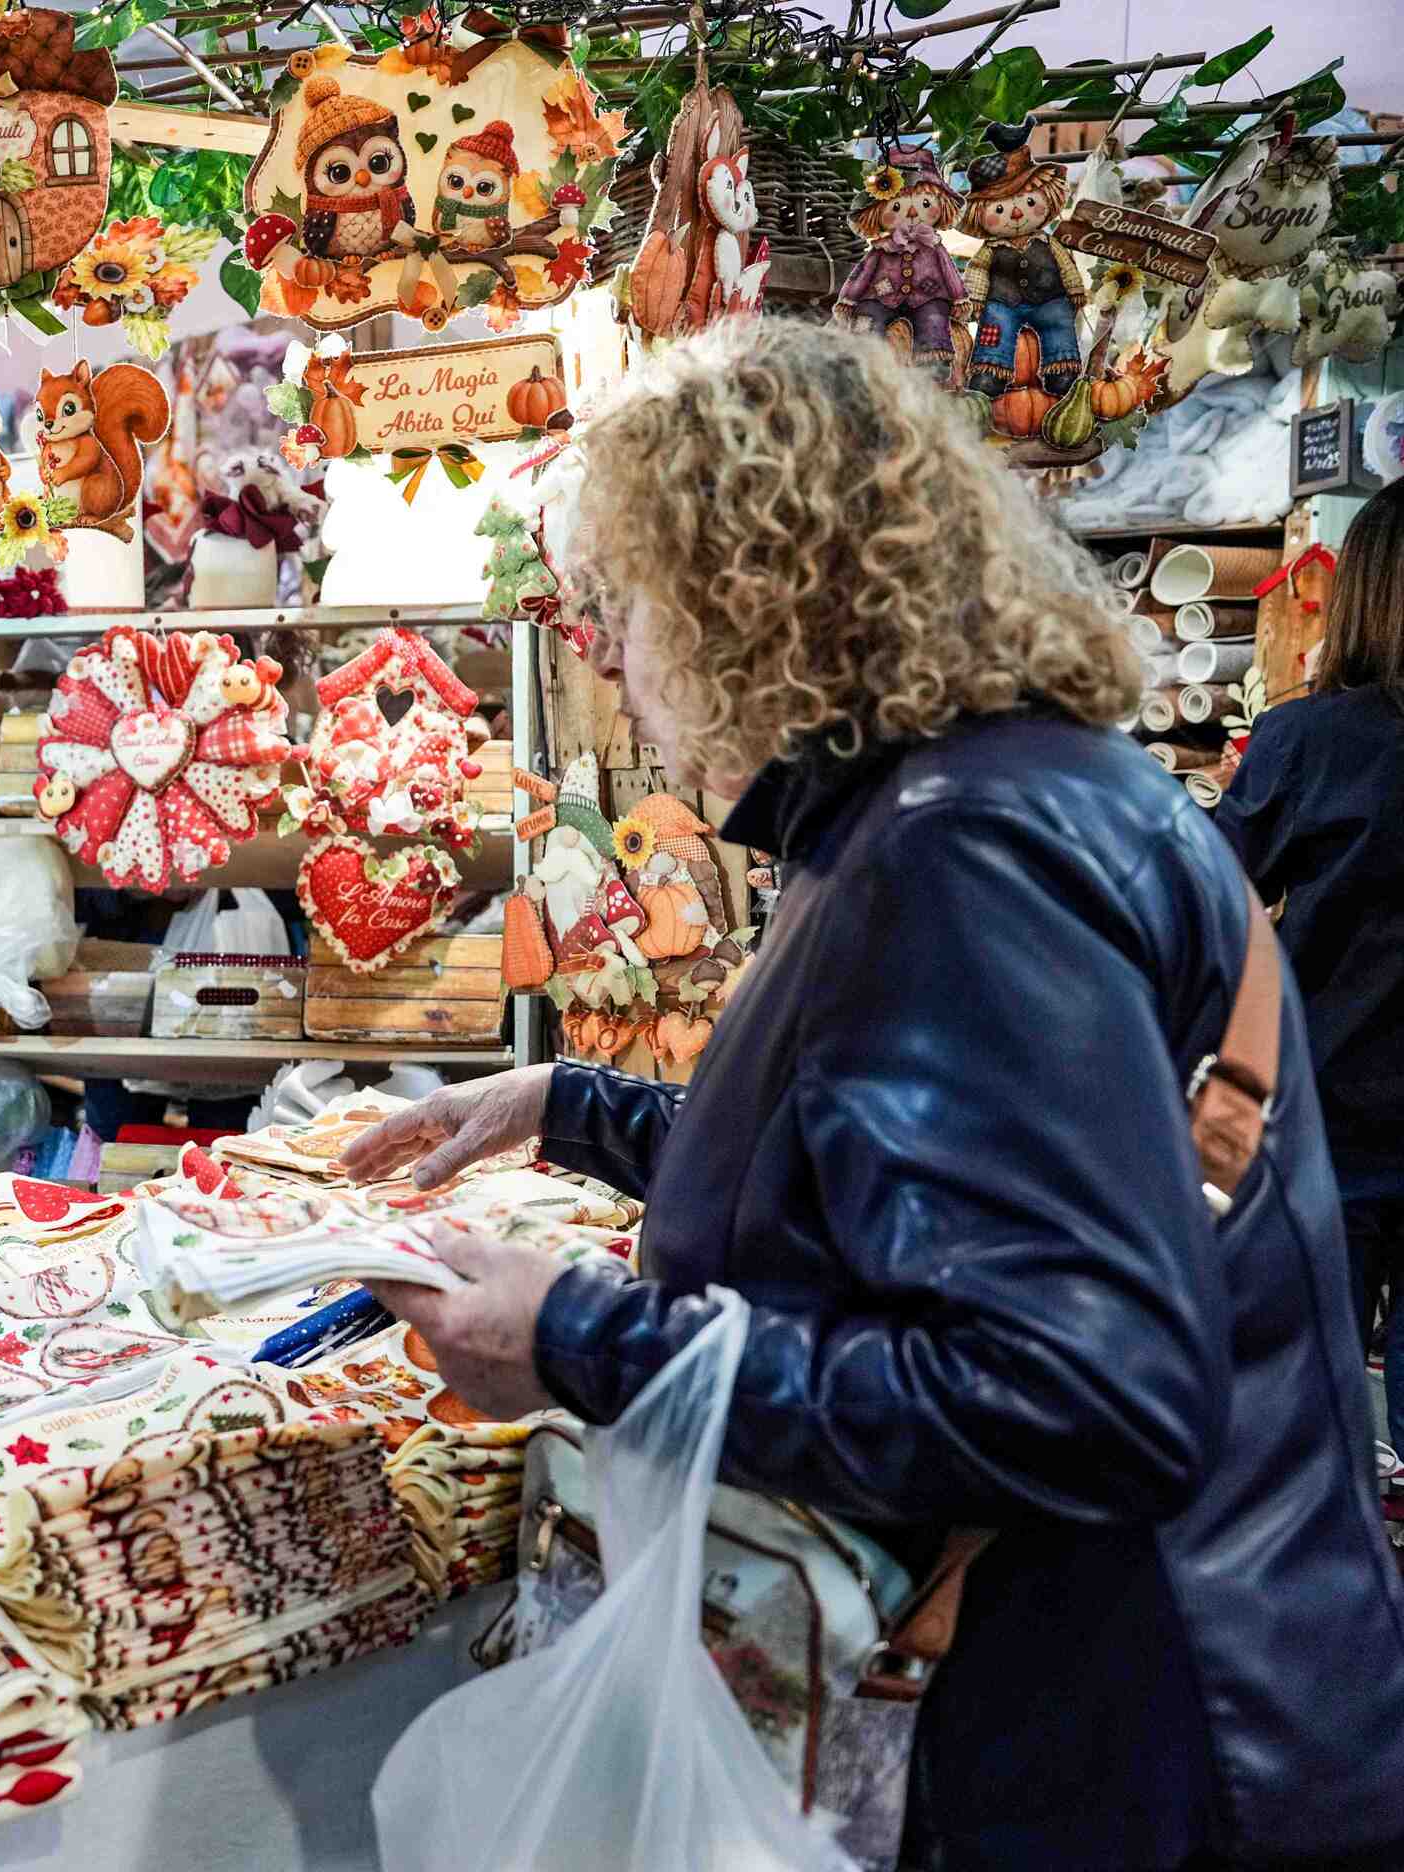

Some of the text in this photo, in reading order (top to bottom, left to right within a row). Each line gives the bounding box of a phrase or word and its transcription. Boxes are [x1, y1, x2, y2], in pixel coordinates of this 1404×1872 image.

[1092, 207, 1203, 253] Benvenuti
[1225, 191, 1320, 245] Sogni
[1078, 232, 1125, 259] Casa
[1127, 246, 1196, 283] Nostra
[374, 367, 500, 400] La Magia
[377, 403, 496, 438] Abita Qui
[337, 904, 411, 929] fa Casa
